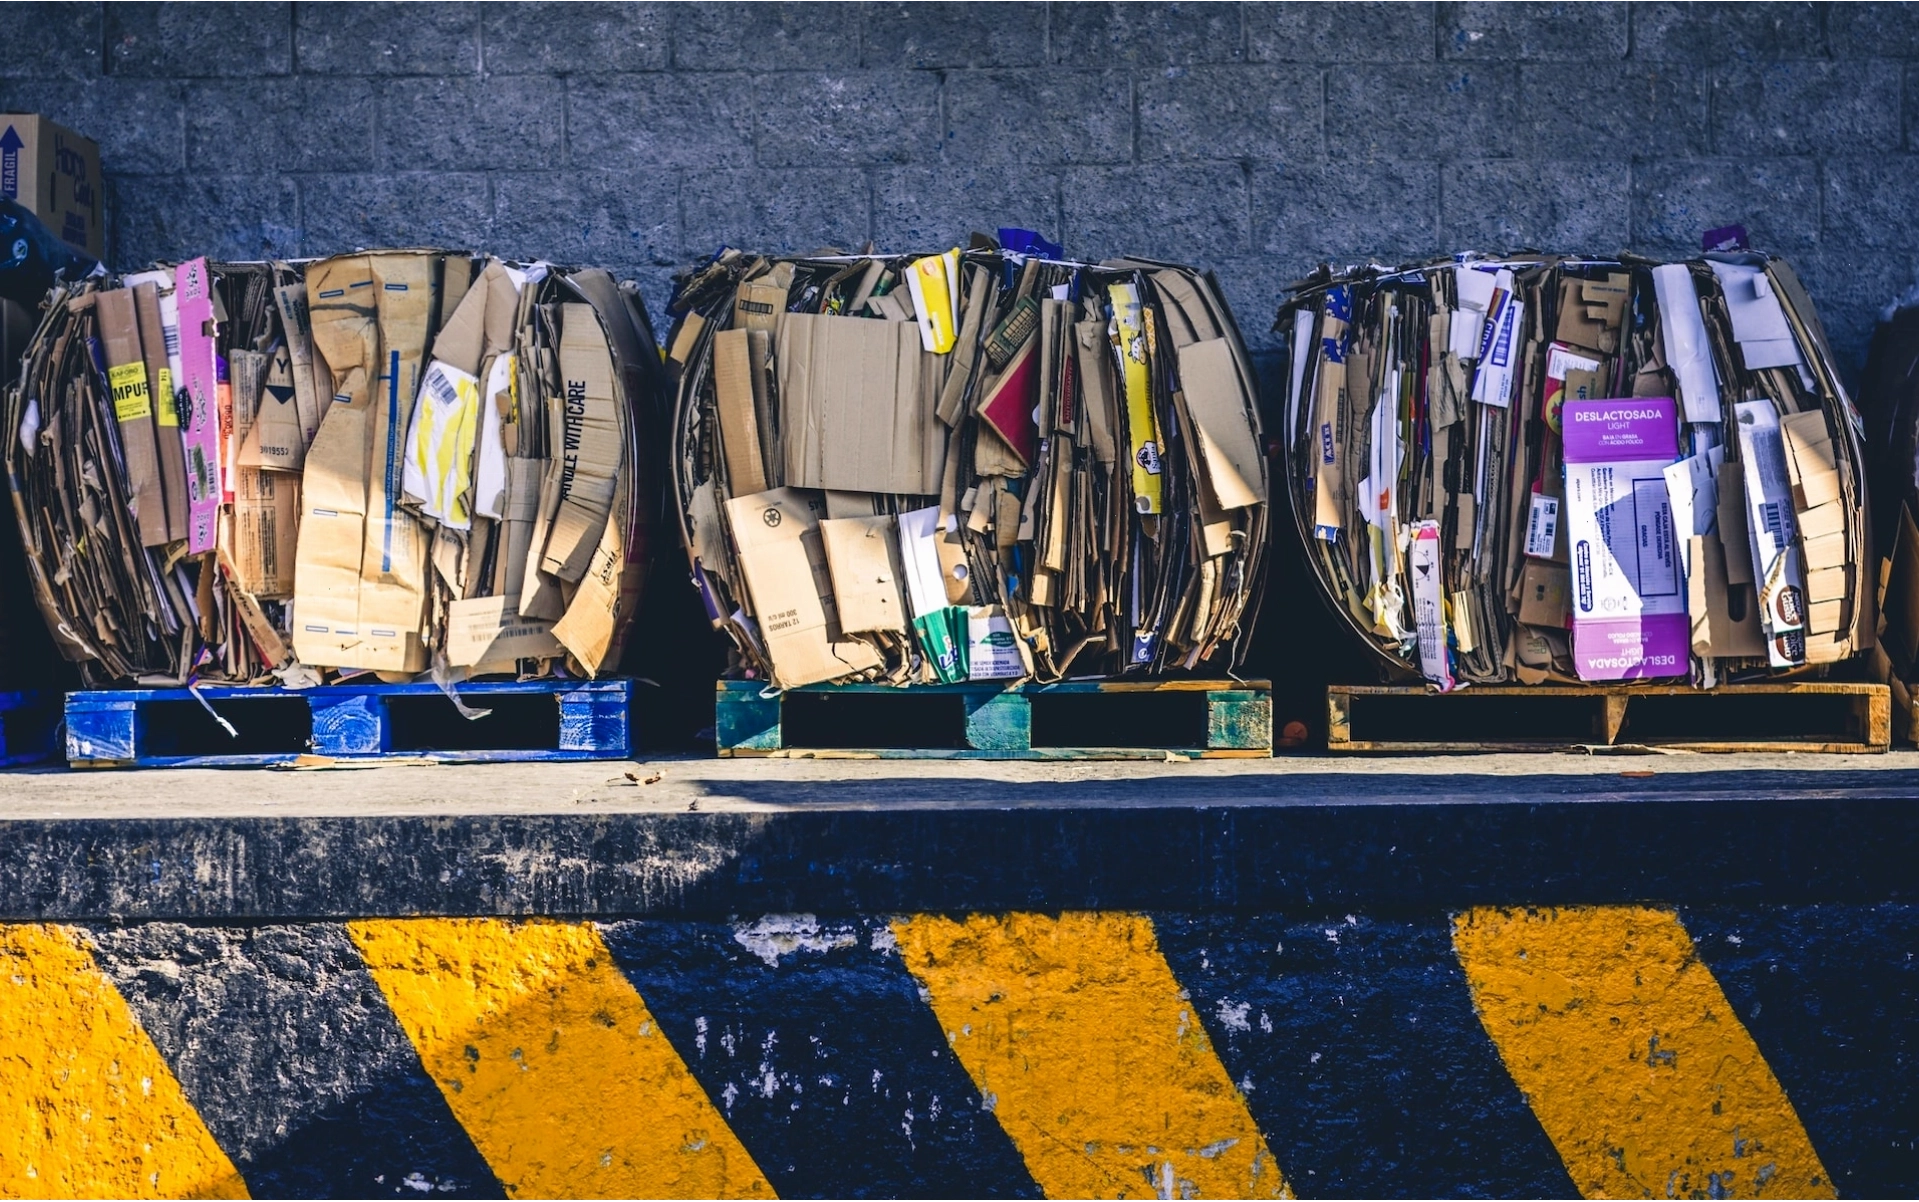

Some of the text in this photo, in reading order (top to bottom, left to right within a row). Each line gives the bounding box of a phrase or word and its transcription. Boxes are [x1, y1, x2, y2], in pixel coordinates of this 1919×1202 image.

[4, 151, 16, 192] FRAGIL
[567, 380, 585, 415] CARE
[1575, 410, 1662, 421] DESLACTOSADA
[565, 418, 583, 450] WITH
[1608, 422, 1630, 430] LIGHT
[1150, 445, 1158, 469] Santa
[786, 609, 797, 617] 300
[1781, 592, 1791, 622] Gusto
[1788, 591, 1798, 621] Dolce
[769, 618, 800, 632] 12 TARROS
[1620, 648, 1642, 656] LIGHT
[1588, 655, 1675, 669] DESLACTOSADA
